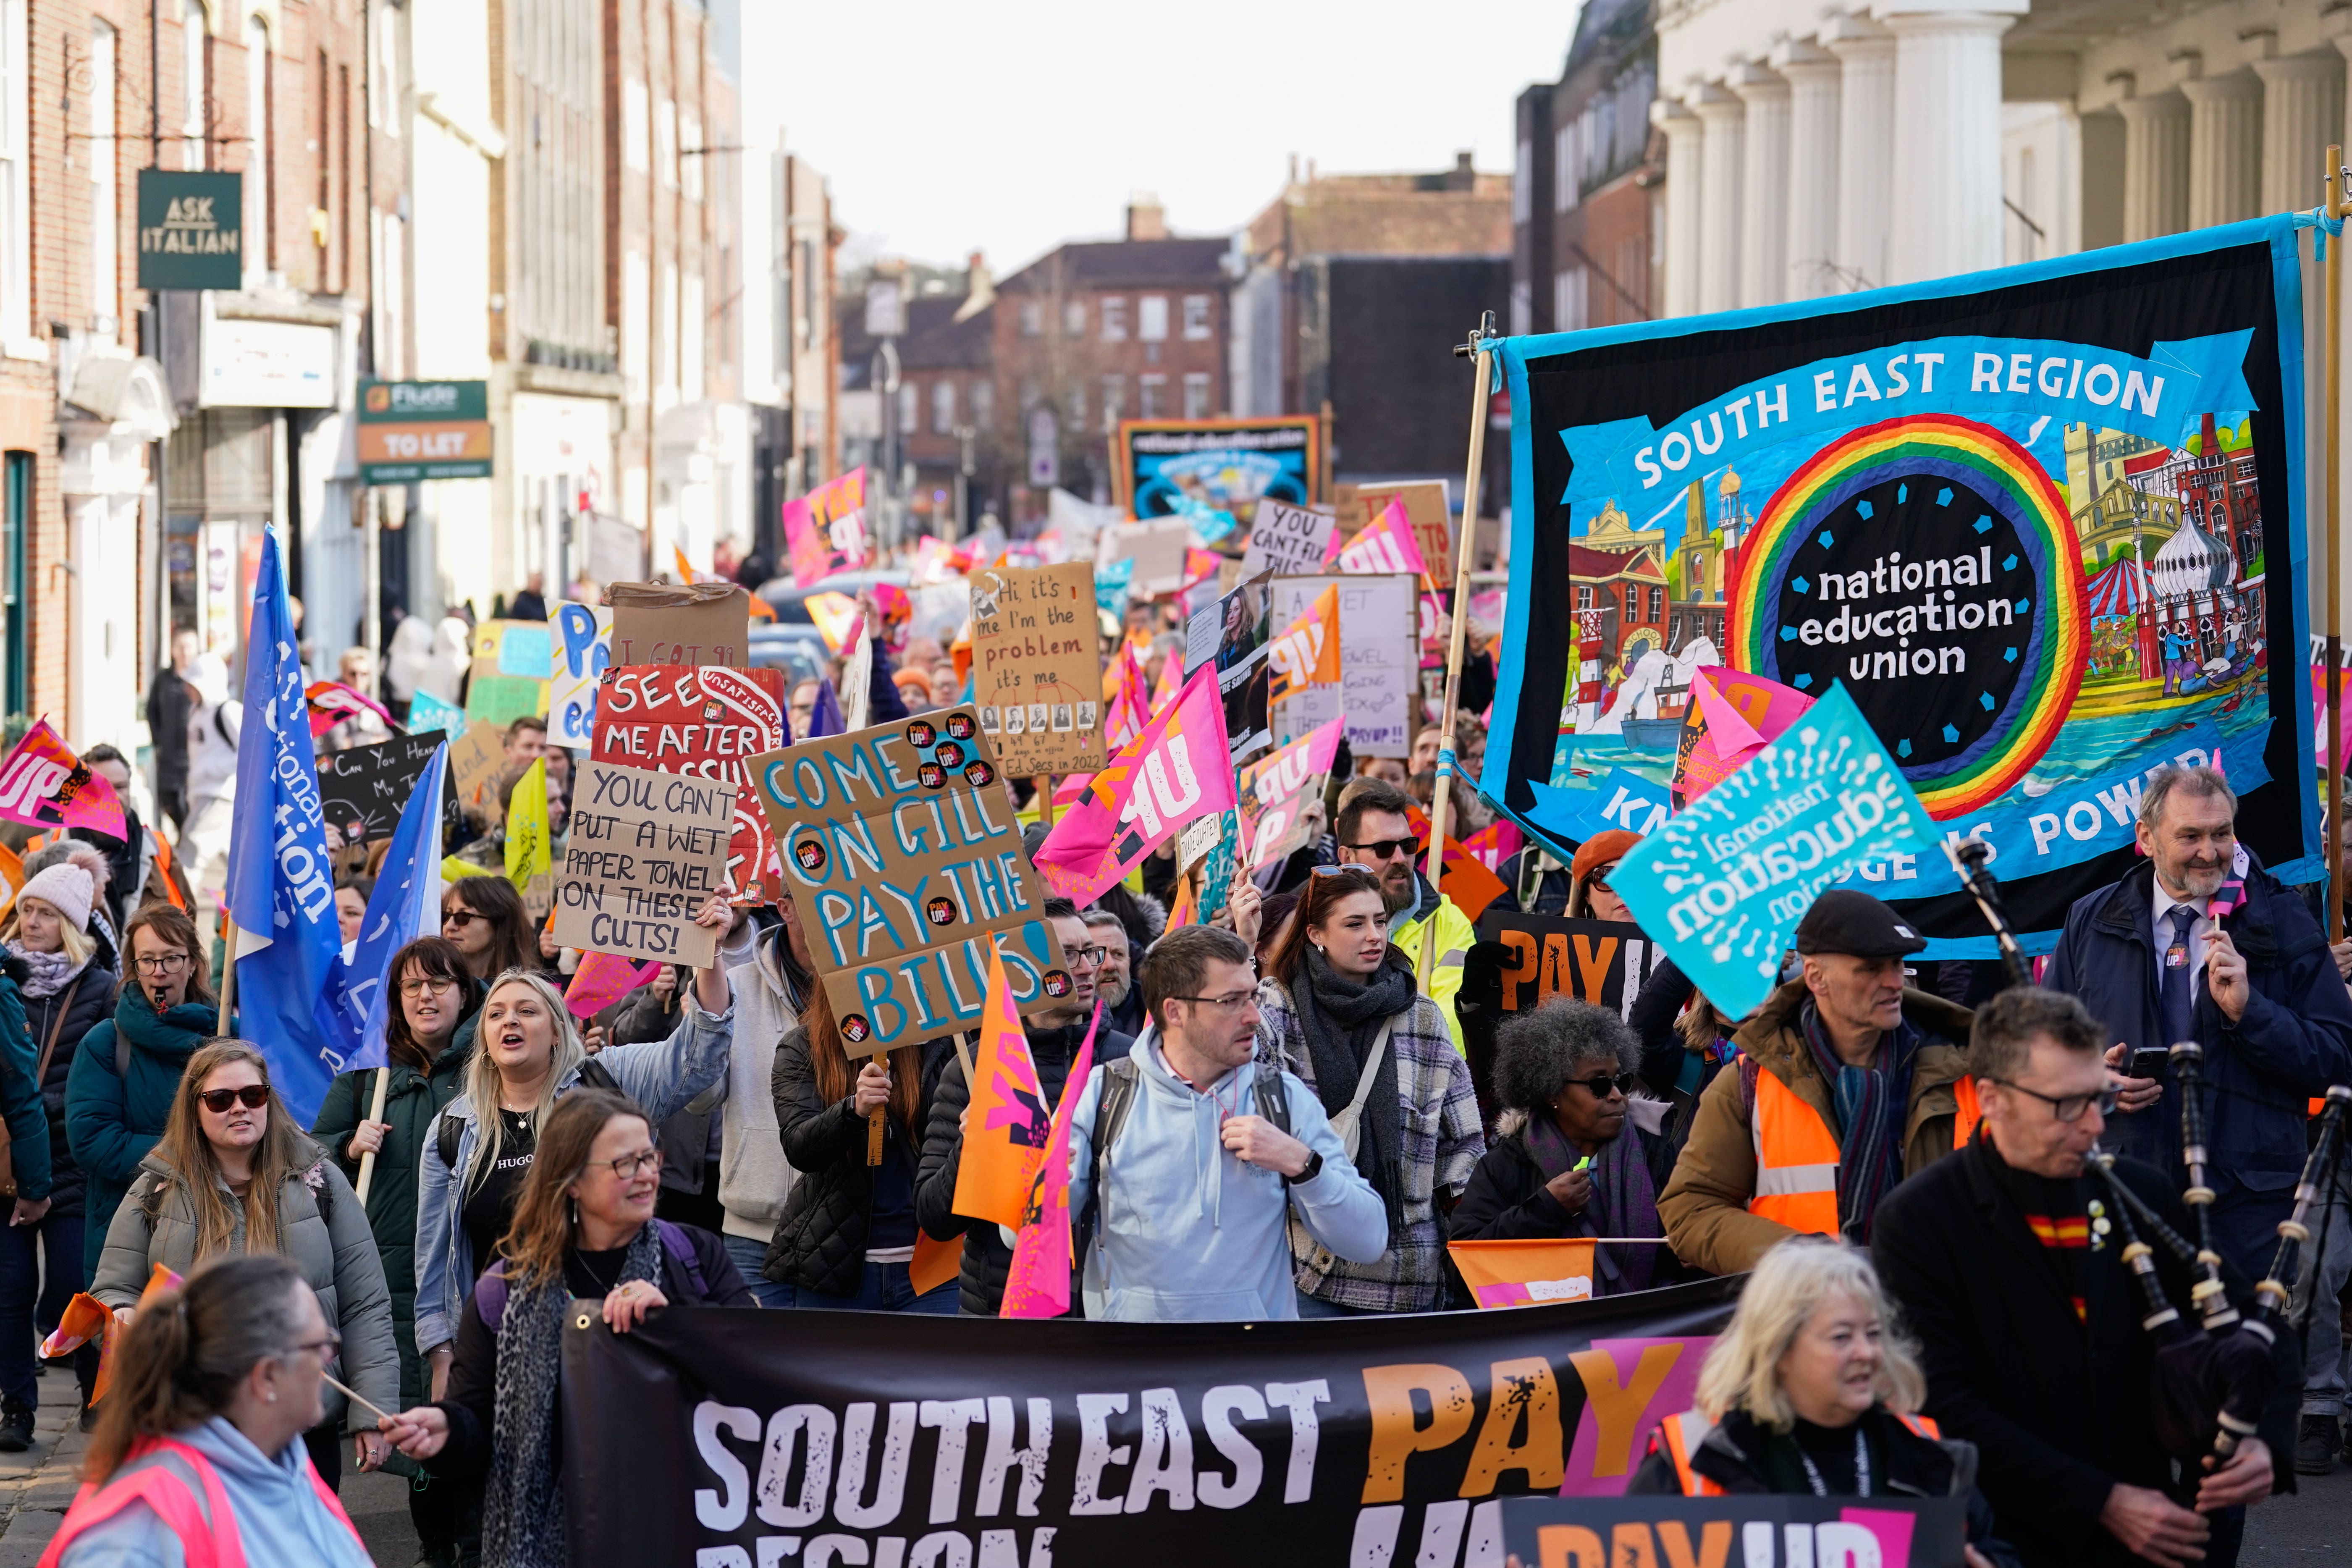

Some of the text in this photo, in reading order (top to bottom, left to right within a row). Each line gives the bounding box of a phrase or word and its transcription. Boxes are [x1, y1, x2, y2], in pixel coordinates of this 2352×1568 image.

[166, 197, 215, 221] ASK
[142, 228, 239, 254] ITALIAN
[1635, 352, 2165, 490] SOUTH EAST REGION
[384, 431, 468, 458] TO LET
[1272, 506, 1318, 536] YOU
[1265, 552, 1302, 574] THIS
[1301, 541, 1327, 562] FIX
[1819, 546, 1991, 600] national
[999, 575, 1060, 603] Hi, it's
[1010, 610, 1036, 629] I'm
[1047, 606, 1075, 625] the
[1799, 589, 2013, 646] education
[1626, 629, 1660, 647] SCHOOL
[620, 639, 634, 667] I
[651, 642, 703, 666] GOT
[986, 635, 1083, 671] problem
[1850, 637, 1965, 680] union
[997, 669, 1058, 689] it's me
[1231, 665, 1252, 691] SAYING
[608, 671, 702, 712] SEE
[948, 717, 968, 726] PAY
[656, 722, 757, 757] AFTER
[936, 745, 955, 756] PAY
[1010, 737, 1023, 746] 49
[1033, 735, 1045, 746] 67
[1059, 733, 1066, 742] 3
[1076, 730, 1095, 739] 289
[1006, 755, 1101, 775] Ed Secs in 2022
[1014, 748, 1030, 758] days
[1045, 747, 1064, 755] office
[764, 733, 919, 809] COME
[920, 766, 939, 775] PAY
[965, 763, 983, 776] PAY
[593, 769, 657, 811] YOU
[666, 781, 737, 821] CAN'T
[574, 810, 726, 855] PUT A WET
[782, 810, 886, 887] ON
[892, 787, 1007, 857] GILL
[797, 843, 817, 855] PAY
[566, 849, 636, 880] PAPER
[642, 860, 715, 893] TOWEL
[747, 883, 760, 891] PAY
[564, 881, 705, 921] ON THESE
[815, 851, 1030, 966] PAY THE
[928, 901, 948, 911] PAY
[591, 913, 679, 955] CUTS!
[2166, 954, 2186, 966] UP!
[2168, 947, 2185, 956] PAY
[1044, 973, 1063, 985] PAY
[1500, 930, 1618, 1012] PAY
[842, 1017, 857, 1035] PAY
[497, 1154, 534, 1170] HUGO
[693, 1342, 1685, 1532] SOUTH EAST PAY
